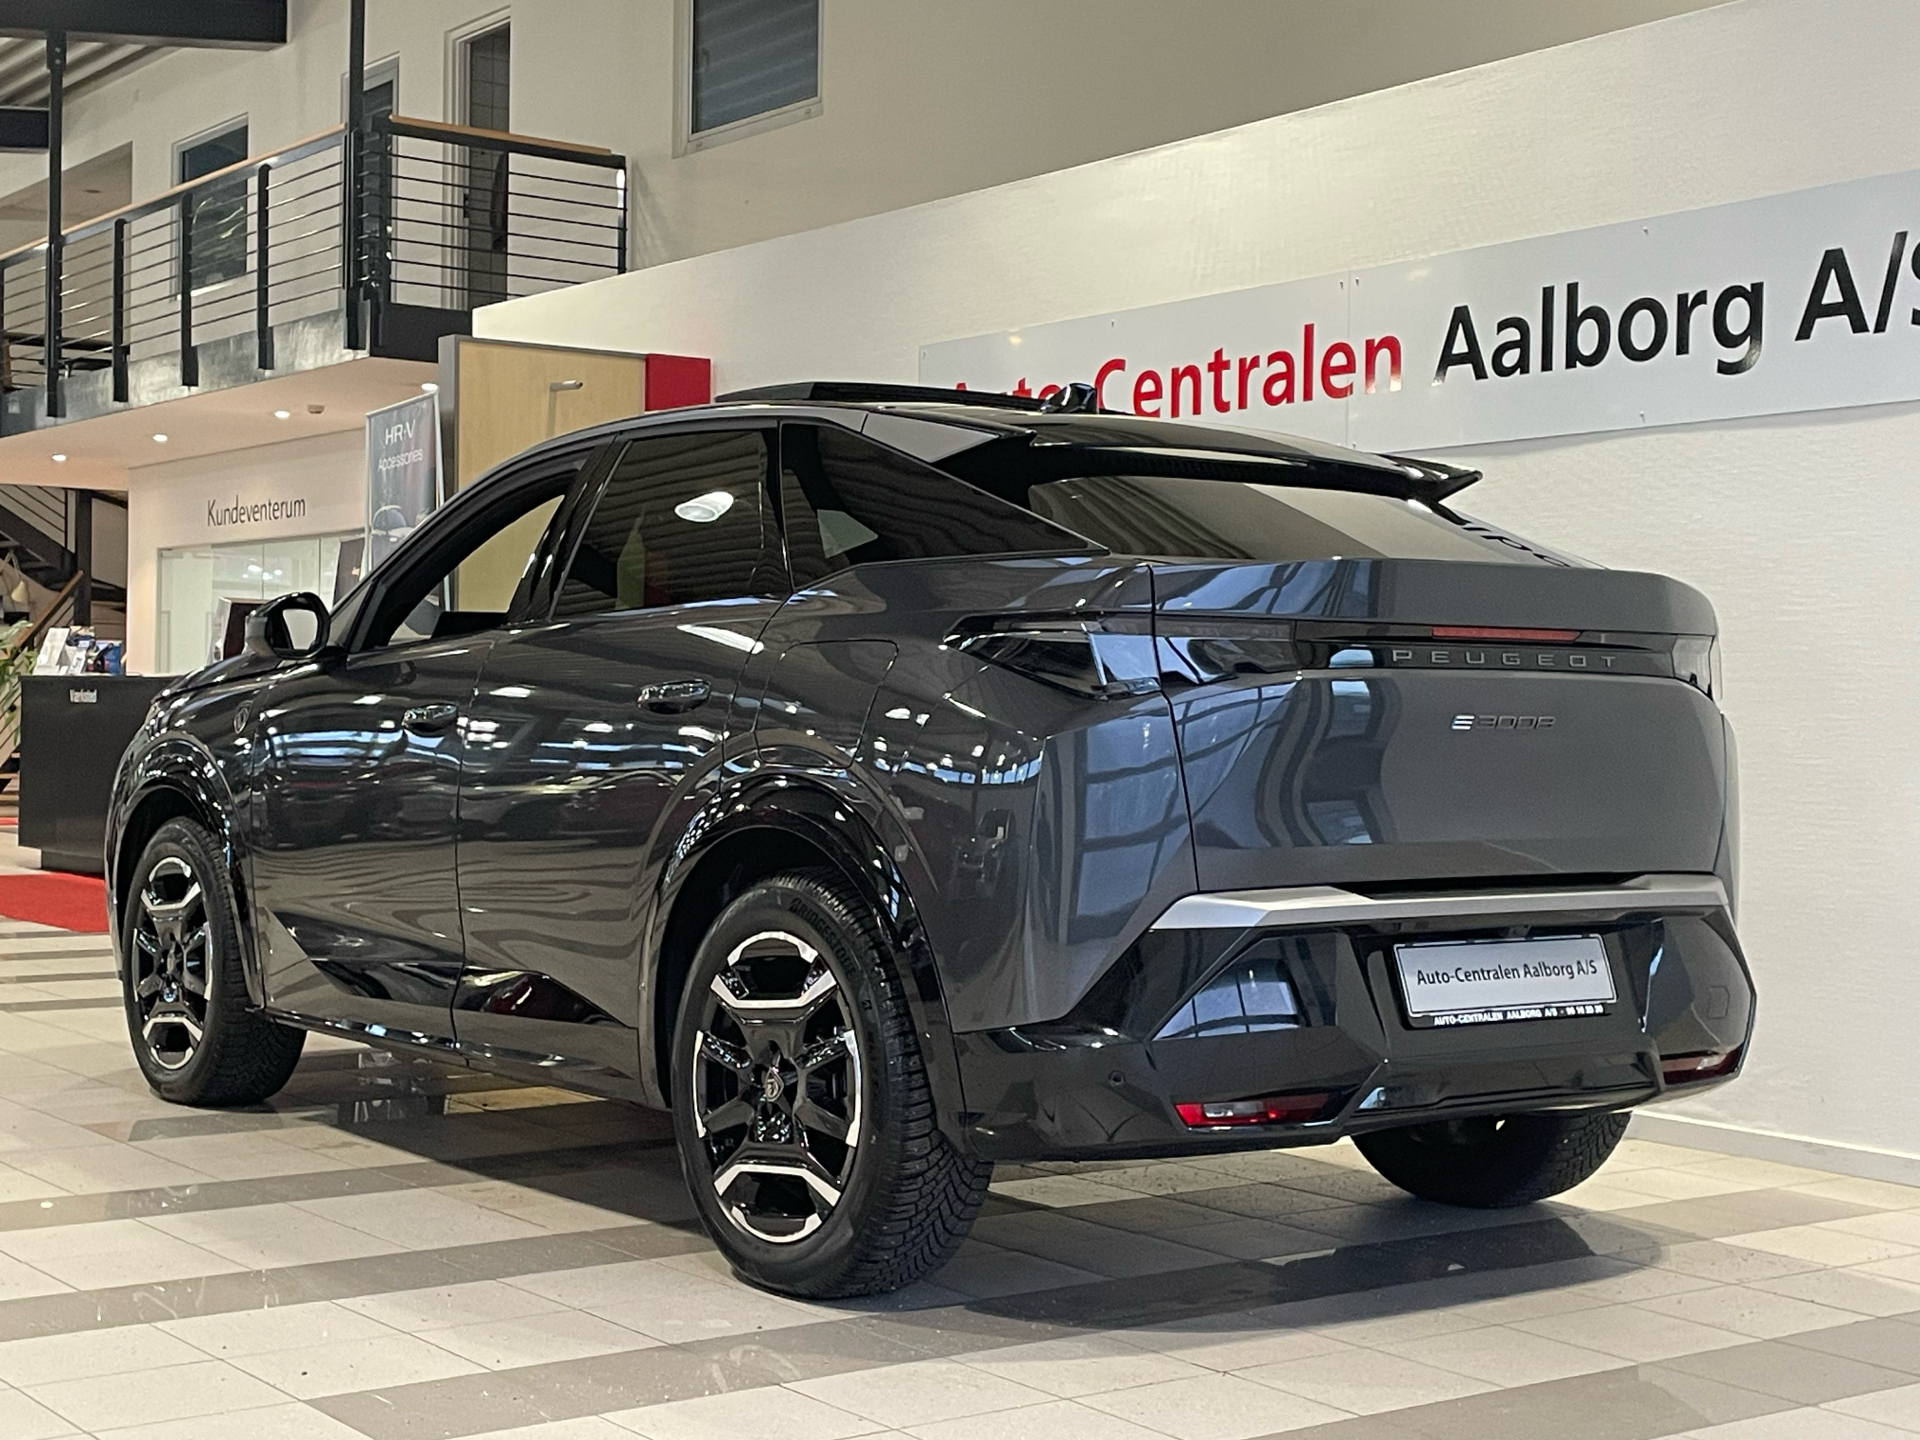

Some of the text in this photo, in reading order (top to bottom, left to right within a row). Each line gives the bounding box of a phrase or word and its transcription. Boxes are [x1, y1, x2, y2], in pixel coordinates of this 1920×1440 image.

[1431, 281, 1764, 387] Aalborg
[1795, 230, 1920, 341] A/
[377, 447, 423, 473] Accessories
[207, 494, 306, 527] Kundeventerum
[1391, 649, 1617, 669] PEUGEOT
[1417, 959, 1598, 986] Auto-Centralen Aalborg A/S
[1433, 1011, 1503, 1026] AUTO-CENTRALEN
[1506, 1008, 1543, 1020] AALBORG
